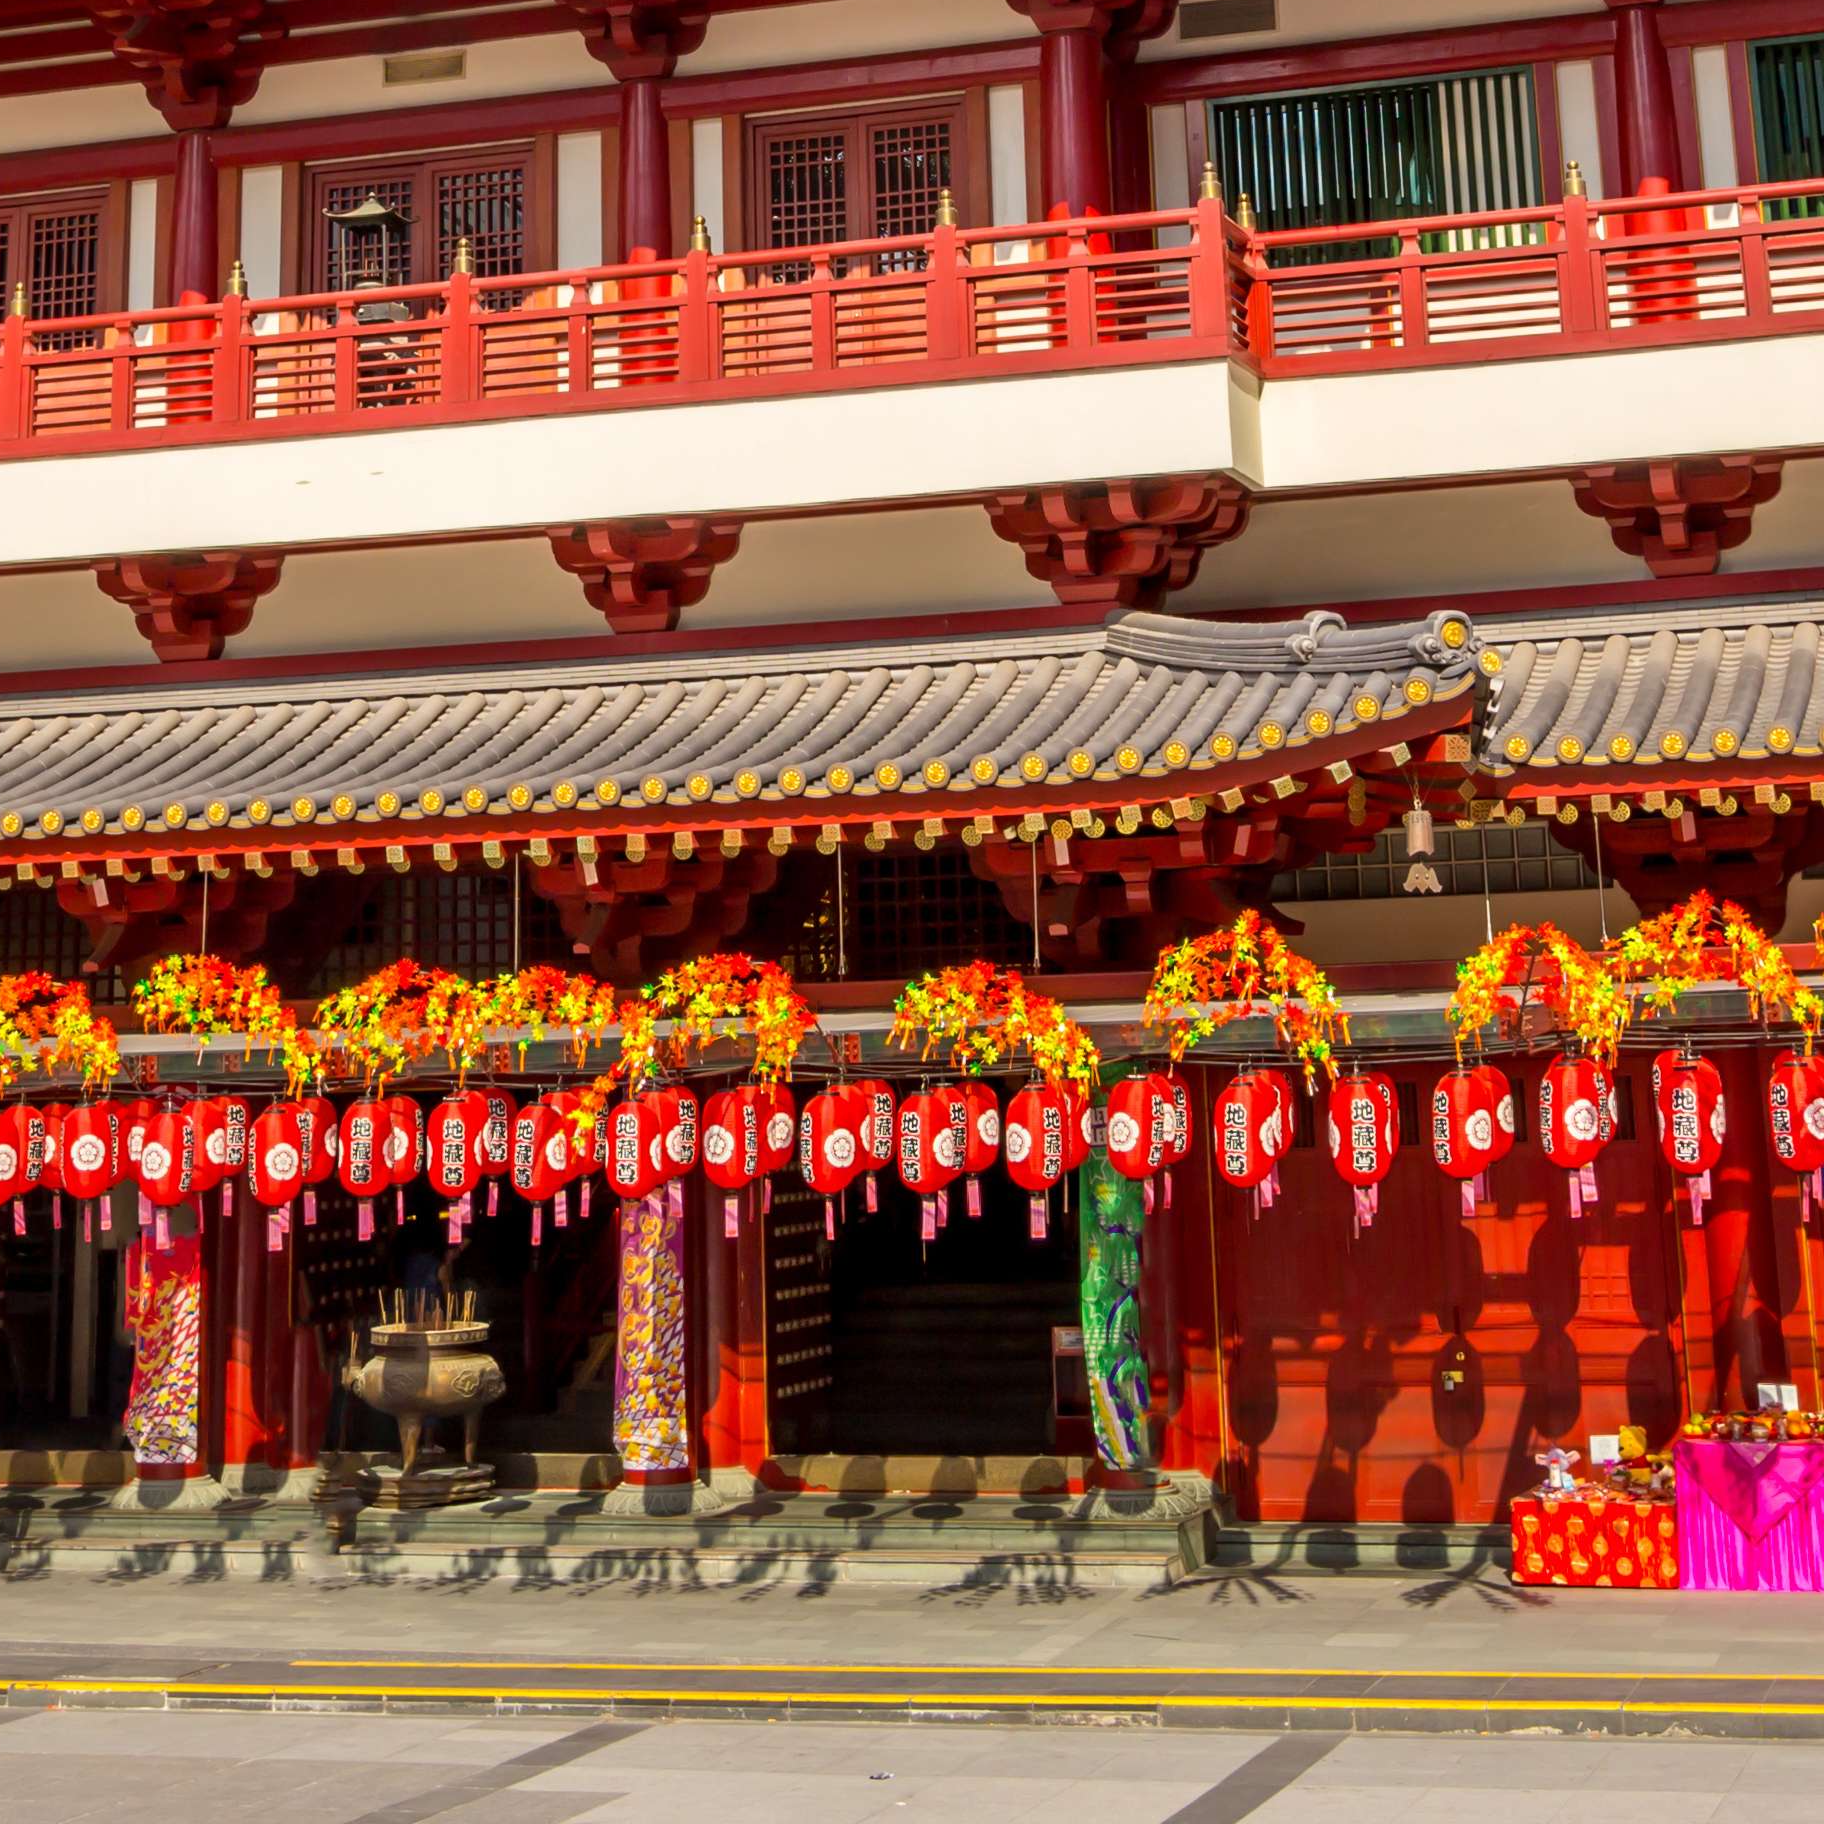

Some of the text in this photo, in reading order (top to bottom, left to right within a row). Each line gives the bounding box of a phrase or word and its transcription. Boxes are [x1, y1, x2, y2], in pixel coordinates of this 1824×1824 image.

[27, 1119, 44, 1180] 地藏尊
[228, 1105, 244, 1164] 地藏尊
[351, 1118, 372, 1183] 地藏尊
[443, 1119, 464, 1187] 地藏尊
[488, 1098, 507, 1162] 地藏尊
[514, 1120, 533, 1188] 地藏尊
[617, 1115, 638, 1184] 地藏尊
[679, 1100, 695, 1164] 地藏尊
[874, 1094, 892, 1159] 地藏尊
[902, 1113, 920, 1182] 地藏尊
[950, 1104, 966, 1170] 地藏尊
[1044, 1108, 1061, 1178] 地藏尊
[1226, 1104, 1246, 1174] 地藏尊
[1353, 1100, 1376, 1172] 地藏尊
[1434, 1092, 1451, 1164] 地藏尊
[1673, 1089, 1698, 1163] 地藏尊
[1771, 1085, 1794, 1158] 地藏尊
